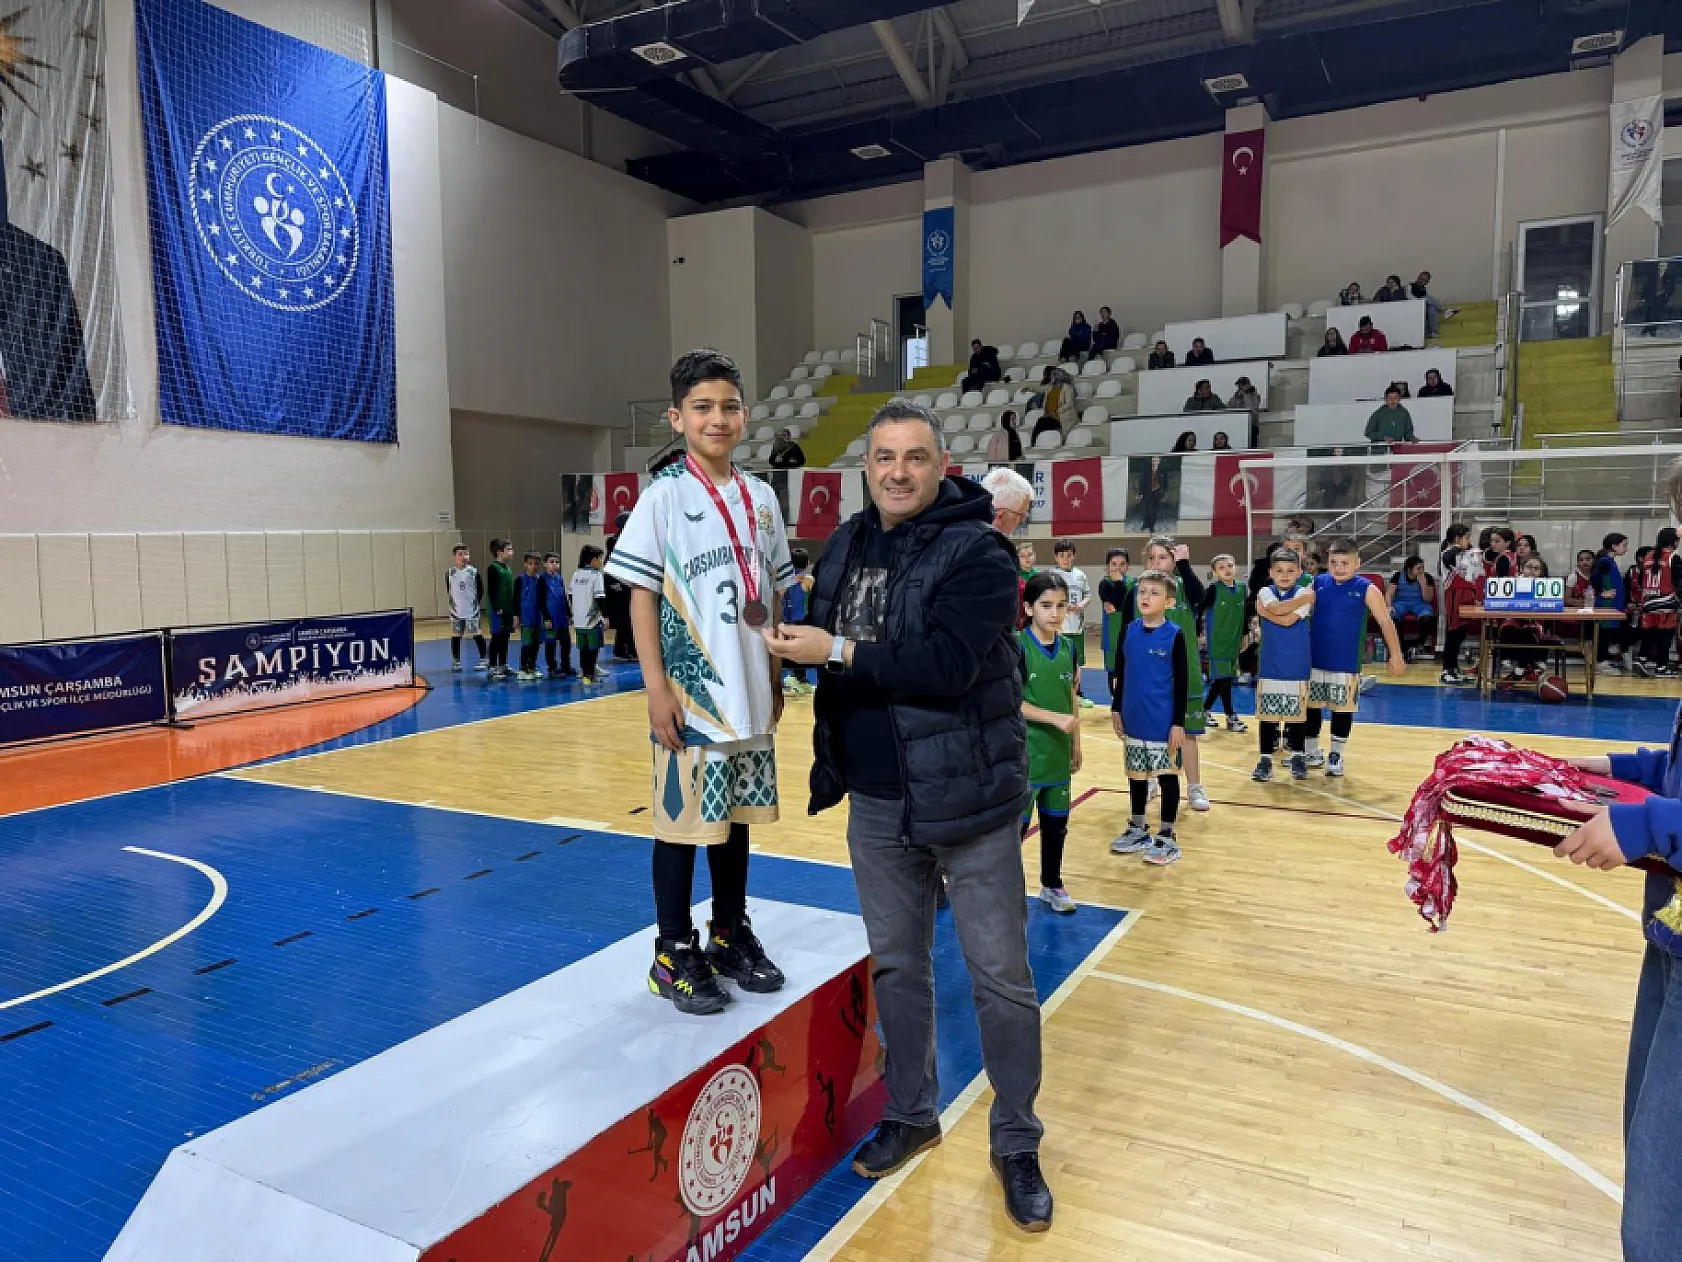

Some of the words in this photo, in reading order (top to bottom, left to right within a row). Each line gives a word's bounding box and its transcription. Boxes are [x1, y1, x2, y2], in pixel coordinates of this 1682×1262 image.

[716, 579, 739, 625] 3
[199, 637, 390, 687] ŞAMPİYON
[0, 701, 25, 714] ÇLİK
[43, 674, 123, 697] ÇARŞAMBA
[676, 1176, 776, 1262] AMSUN
